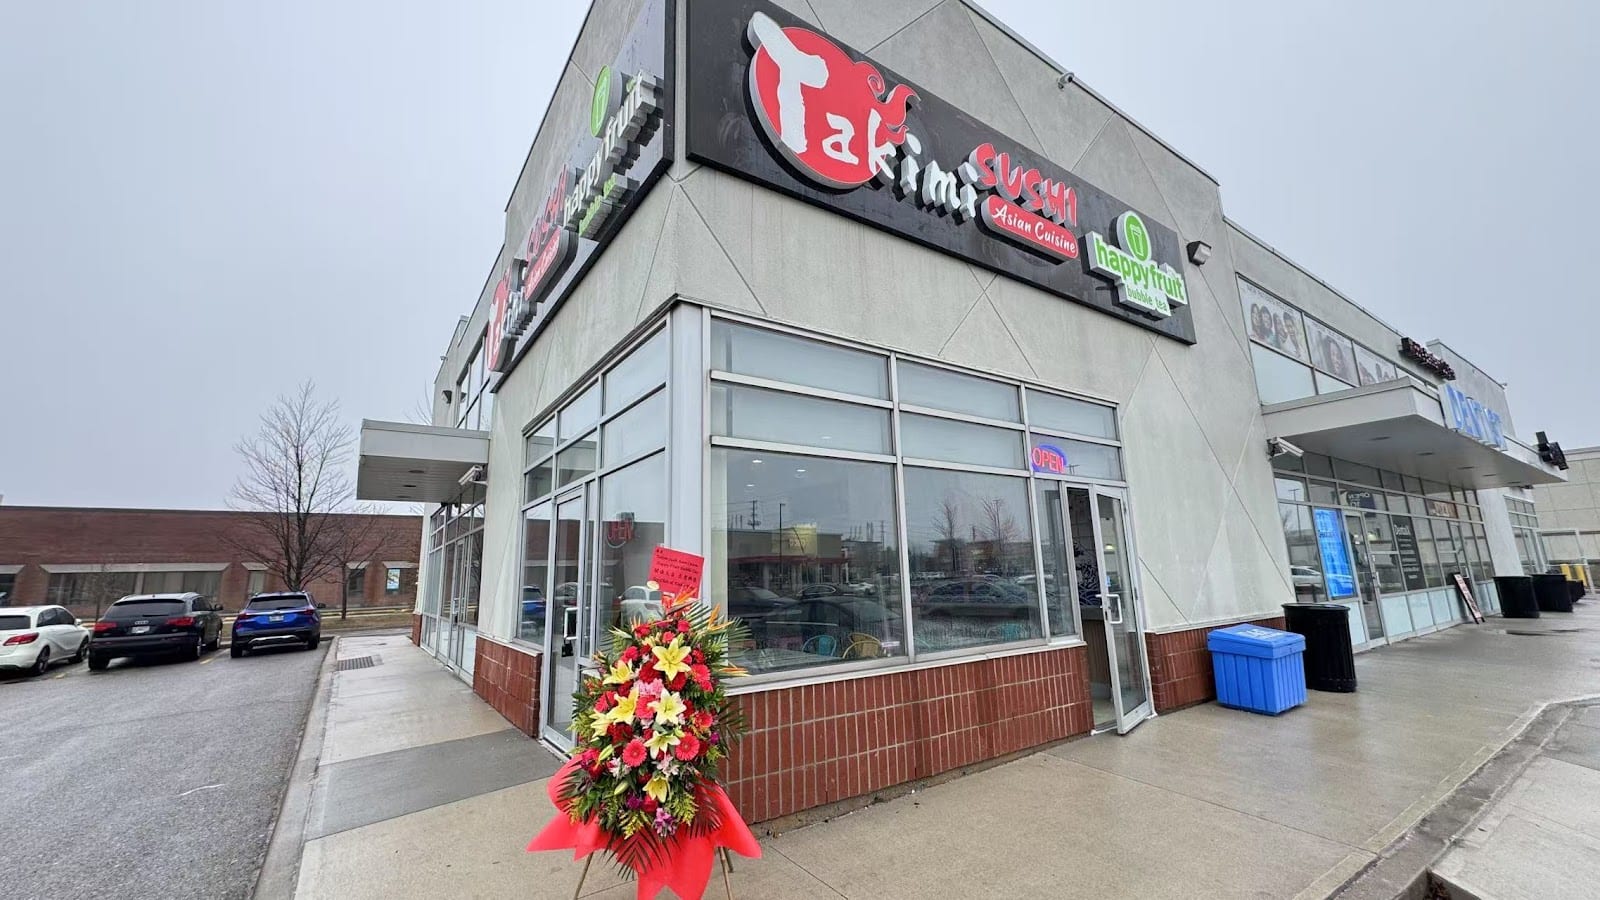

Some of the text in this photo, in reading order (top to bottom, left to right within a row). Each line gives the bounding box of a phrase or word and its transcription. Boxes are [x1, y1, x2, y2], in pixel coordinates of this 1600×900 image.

[752, 12, 977, 218] Takimi
[974, 143, 1077, 228] SUSHI
[992, 205, 1076, 253] Asian Cuisine
[1127, 284, 1168, 312] bubble tea
[1032, 447, 1065, 473] OPEN
